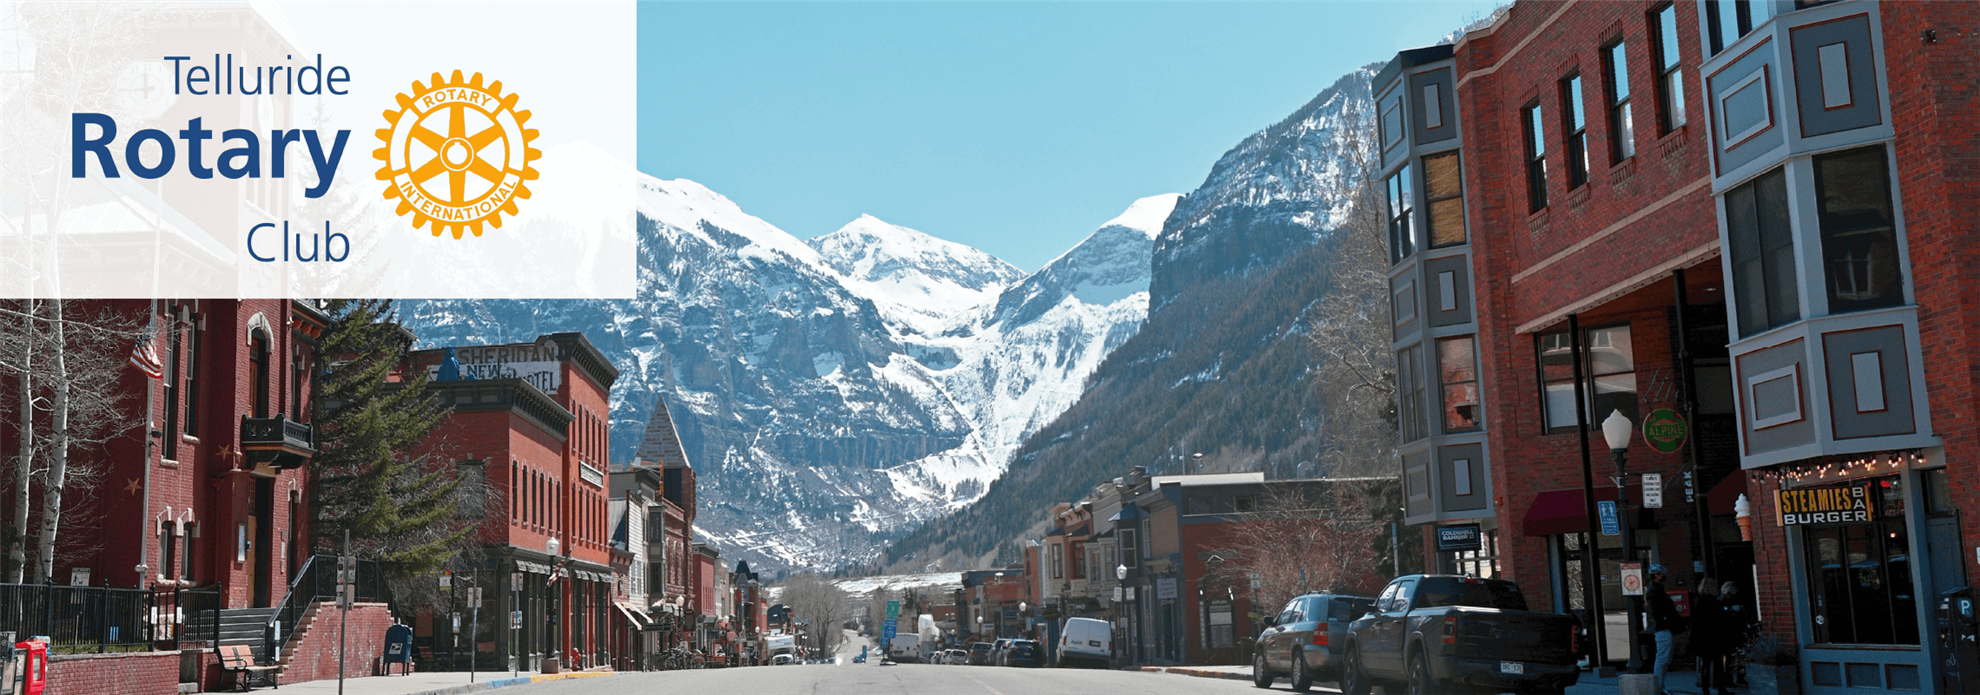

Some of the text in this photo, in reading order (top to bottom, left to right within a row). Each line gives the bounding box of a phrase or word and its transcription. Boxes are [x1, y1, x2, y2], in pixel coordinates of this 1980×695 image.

[459, 346, 556, 365] SHERIDAN
[466, 364, 502, 379] NEW
[525, 371, 557, 392] OTEL
[1649, 424, 1683, 437] ALPINE
[1683, 471, 1694, 502] PEAK
[1781, 488, 1852, 513] STEAMIES
[1784, 511, 1867, 525] BURGER
[1960, 600, 1970, 615] P
